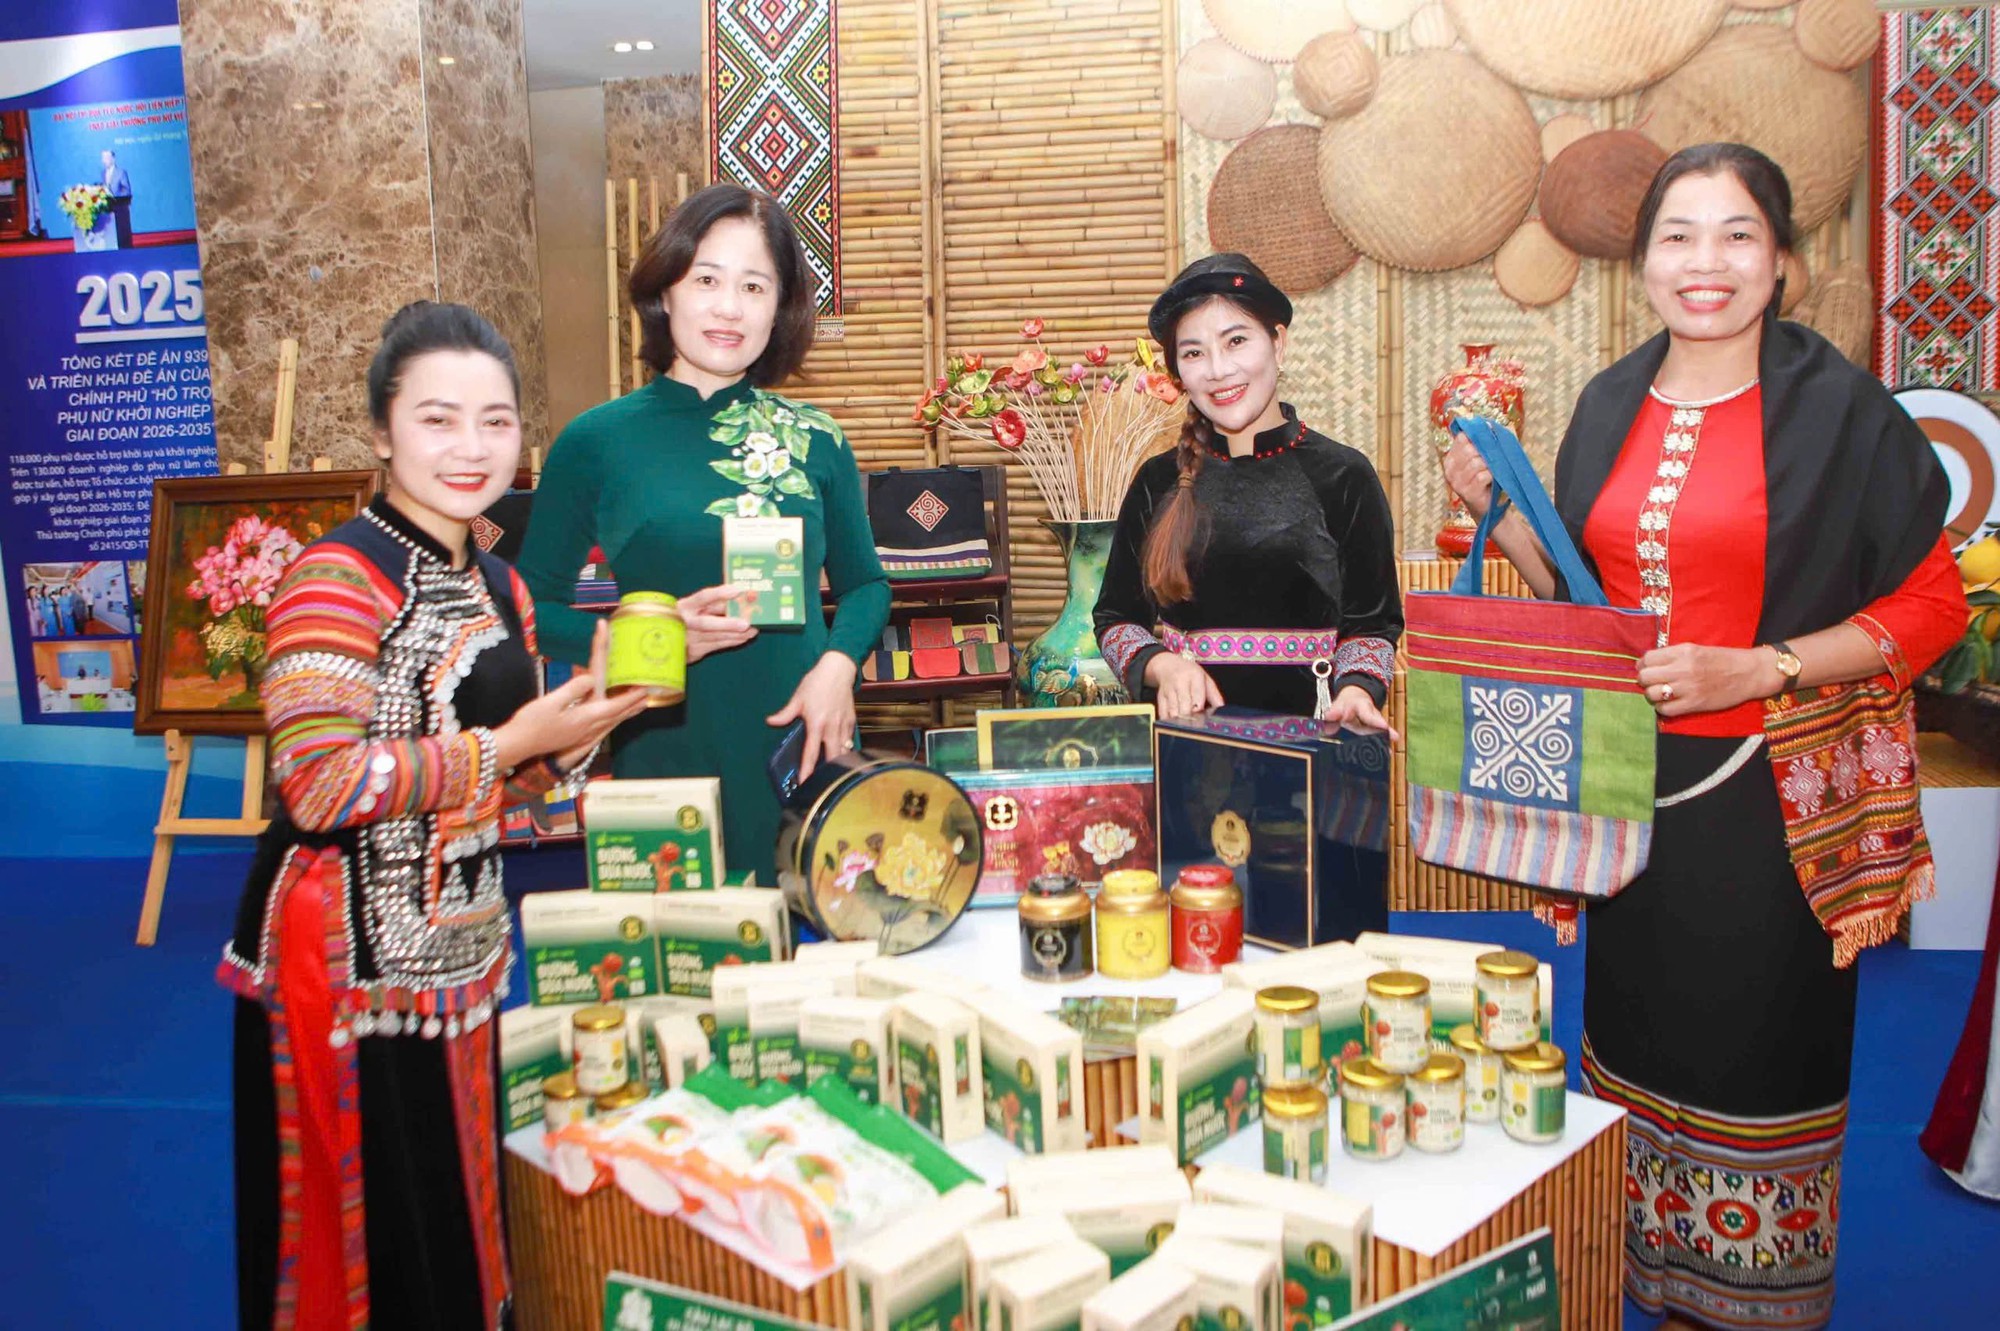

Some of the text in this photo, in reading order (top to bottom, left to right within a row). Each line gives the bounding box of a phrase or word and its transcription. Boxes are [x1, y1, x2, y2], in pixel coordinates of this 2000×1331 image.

[76, 270, 204, 327] 2025
[61, 348, 208, 370] TỔNG KẾT ĐỀ ÁN 939
[28, 366, 211, 390] VÀ TRIỂN KHAI ĐỀ ÁN CỦA
[69, 390, 114, 406] CHÍNH
[117, 387, 147, 403] PHỦ
[182, 385, 213, 402] TRỢ
[57, 404, 211, 426] PHỤ NỮ KHỞI NGHIỆP
[66, 428, 94, 442] GIAI
[99, 425, 139, 442] ĐOẠN
[10, 467, 30, 477] Trên
[33, 466, 65, 476] 130.000
[68, 465, 96, 474] doanh
[98, 463, 129, 474] nghiệp
[132, 462, 144, 471] do
[147, 461, 165, 471] phụ
[169, 461, 181, 469] nữ
[184, 459, 201, 469] làm
[123, 476, 139, 485] các
[14, 493, 31, 504] góp
[56, 491, 80, 502] dựng
[81, 490, 94, 500] Đề
[50, 505, 65, 516] giai
[66, 504, 87, 514] đoạn
[73, 517, 103, 528] nghiệp
[104, 516, 120, 527] giai
[120, 514, 142, 525] đoạn
[36, 530, 53, 540] Thủ
[54, 529, 79, 541] tướng
[81, 528, 105, 538] Chính
[106, 527, 123, 539] phủ
[89, 540, 99, 551] số
